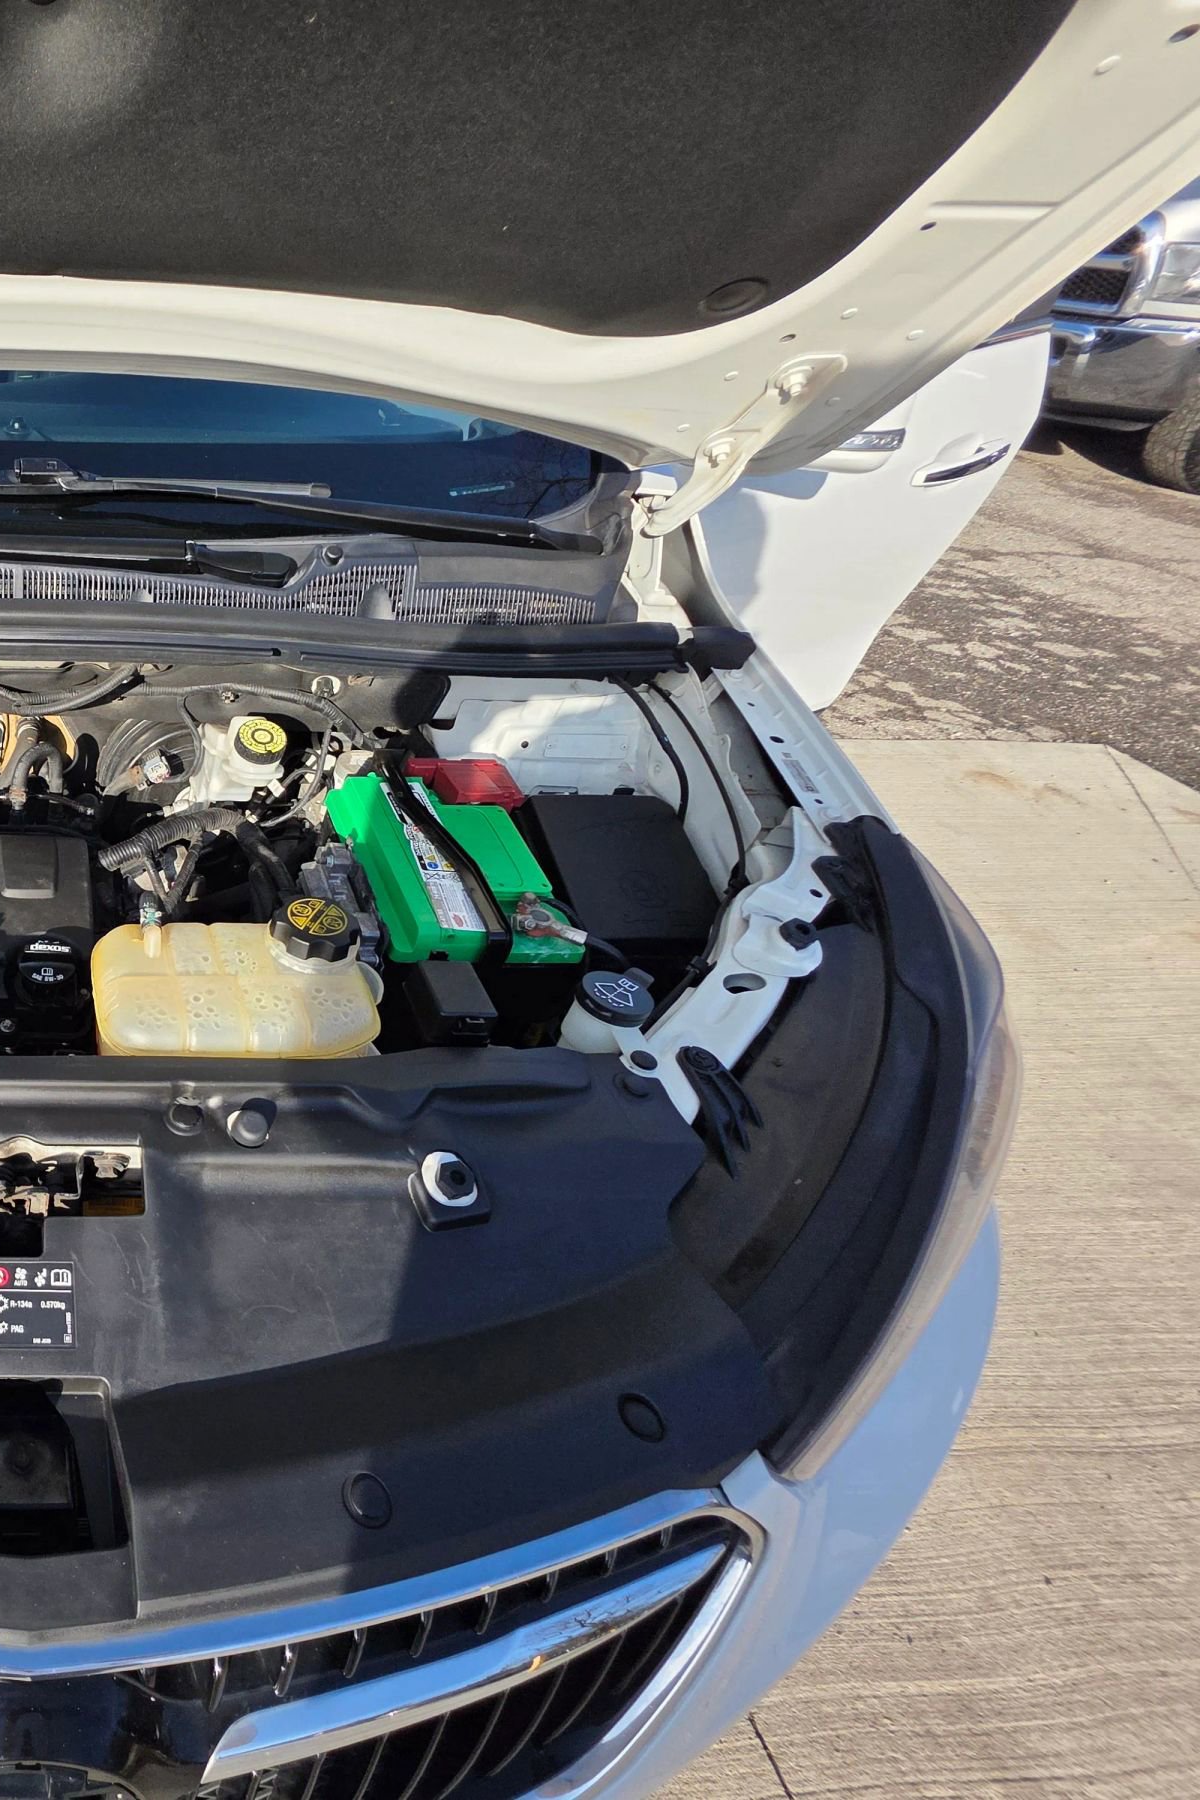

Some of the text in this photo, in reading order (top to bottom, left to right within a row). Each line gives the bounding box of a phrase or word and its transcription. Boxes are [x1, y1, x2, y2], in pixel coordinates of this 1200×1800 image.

[30, 942, 72, 953] dexos
[10, 1300, 32, 1308] R-134a
[10, 1325, 24, 1333] PAG
